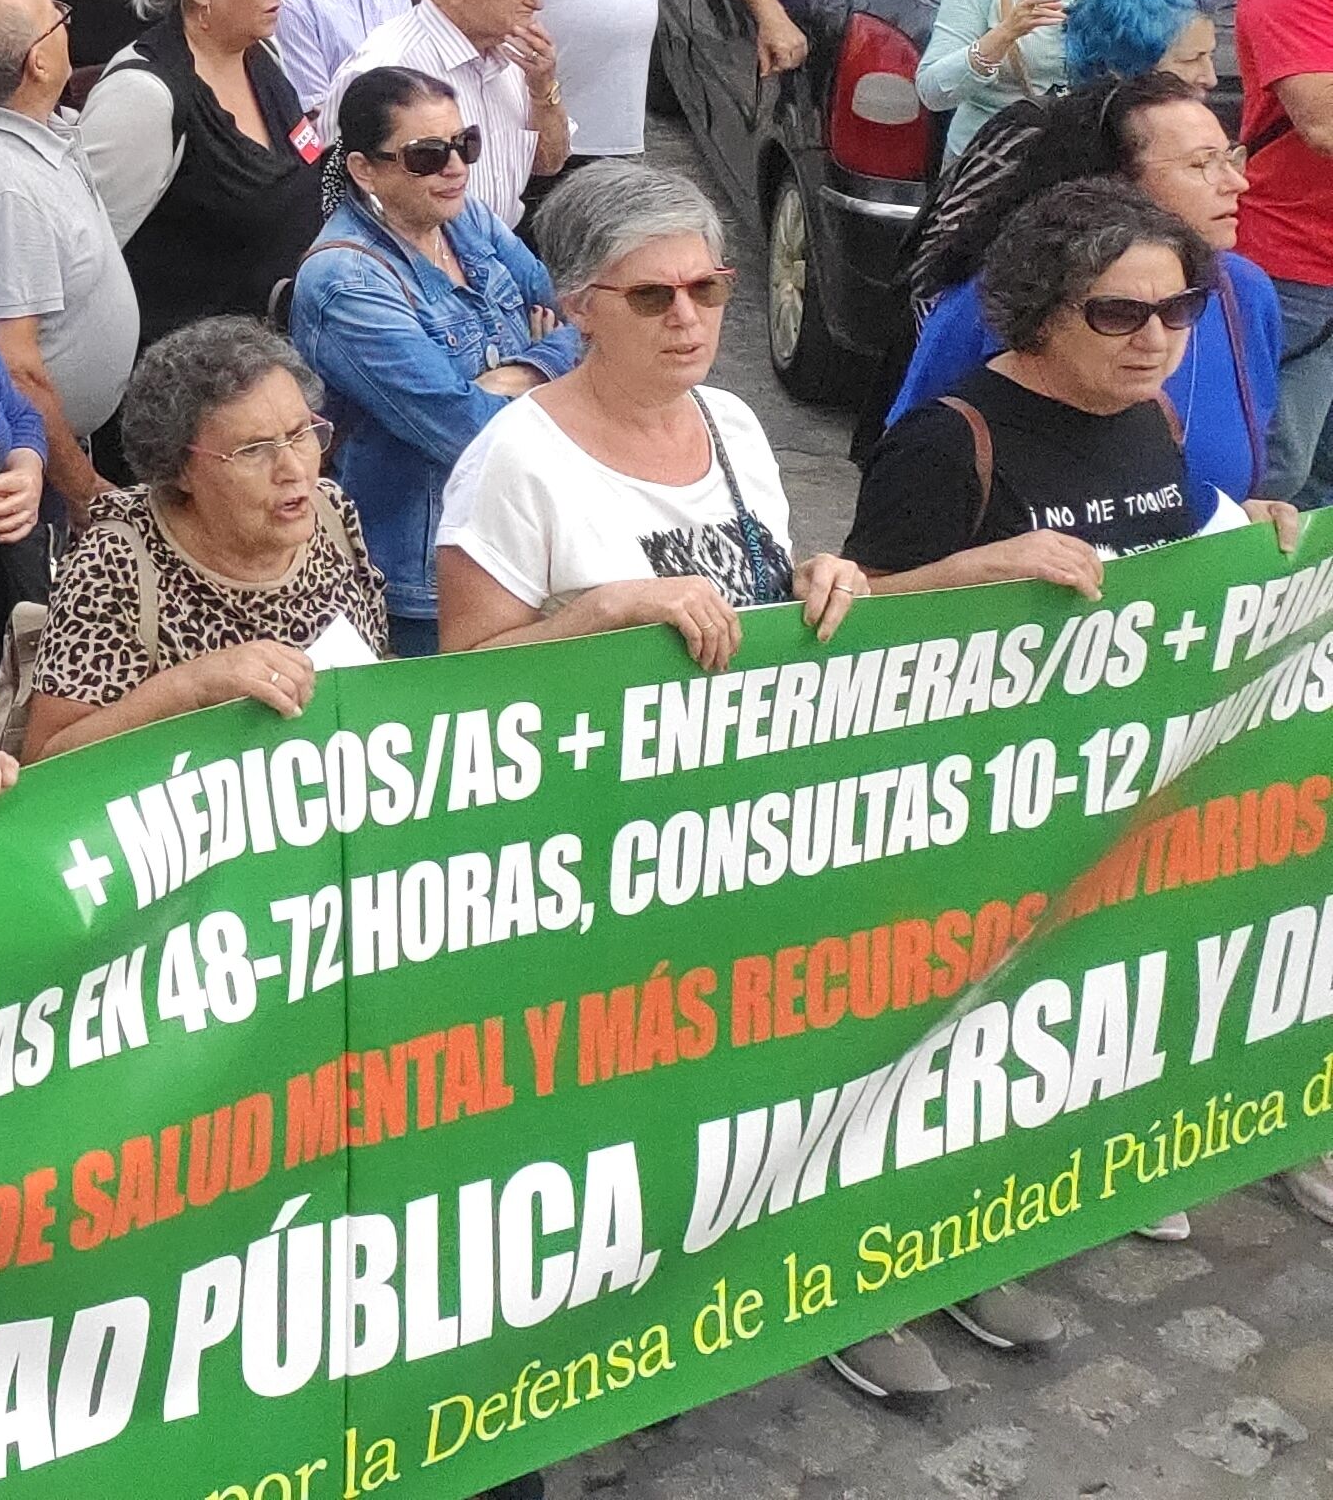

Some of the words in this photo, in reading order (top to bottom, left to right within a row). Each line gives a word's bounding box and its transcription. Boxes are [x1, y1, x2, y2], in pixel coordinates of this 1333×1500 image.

[1085, 498, 1117, 524] ME
[1123, 483, 1183, 517] TOQUES
[68, 944, 151, 1070] EN
[156, 882, 345, 1036] 48-72
[351, 831, 595, 978] HORAS,
[610, 753, 973, 918] CONSULTAS
[983, 721, 1151, 836] 10-12
[106, 700, 543, 912] MÉDICOS/AS
[618, 599, 1156, 784] ENFERMERAS/OS
[69, 1091, 275, 1252] SALUD
[283, 1014, 514, 1170] MENTAL
[523, 1000, 567, 1097] Y
[577, 959, 719, 1087] MÁS
[161, 1141, 662, 1424] PÚBLICA,
[681, 949, 1169, 1255] UNIVERSAL
[1188, 923, 1255, 1067] Y
[343, 1427, 400, 1500] la
[420, 1323, 678, 1468] Defensa
[692, 1279, 765, 1356] de
[783, 1251, 839, 1324] la
[855, 1149, 1083, 1294] Sanidad
[1100, 1088, 1289, 1201] Pública
